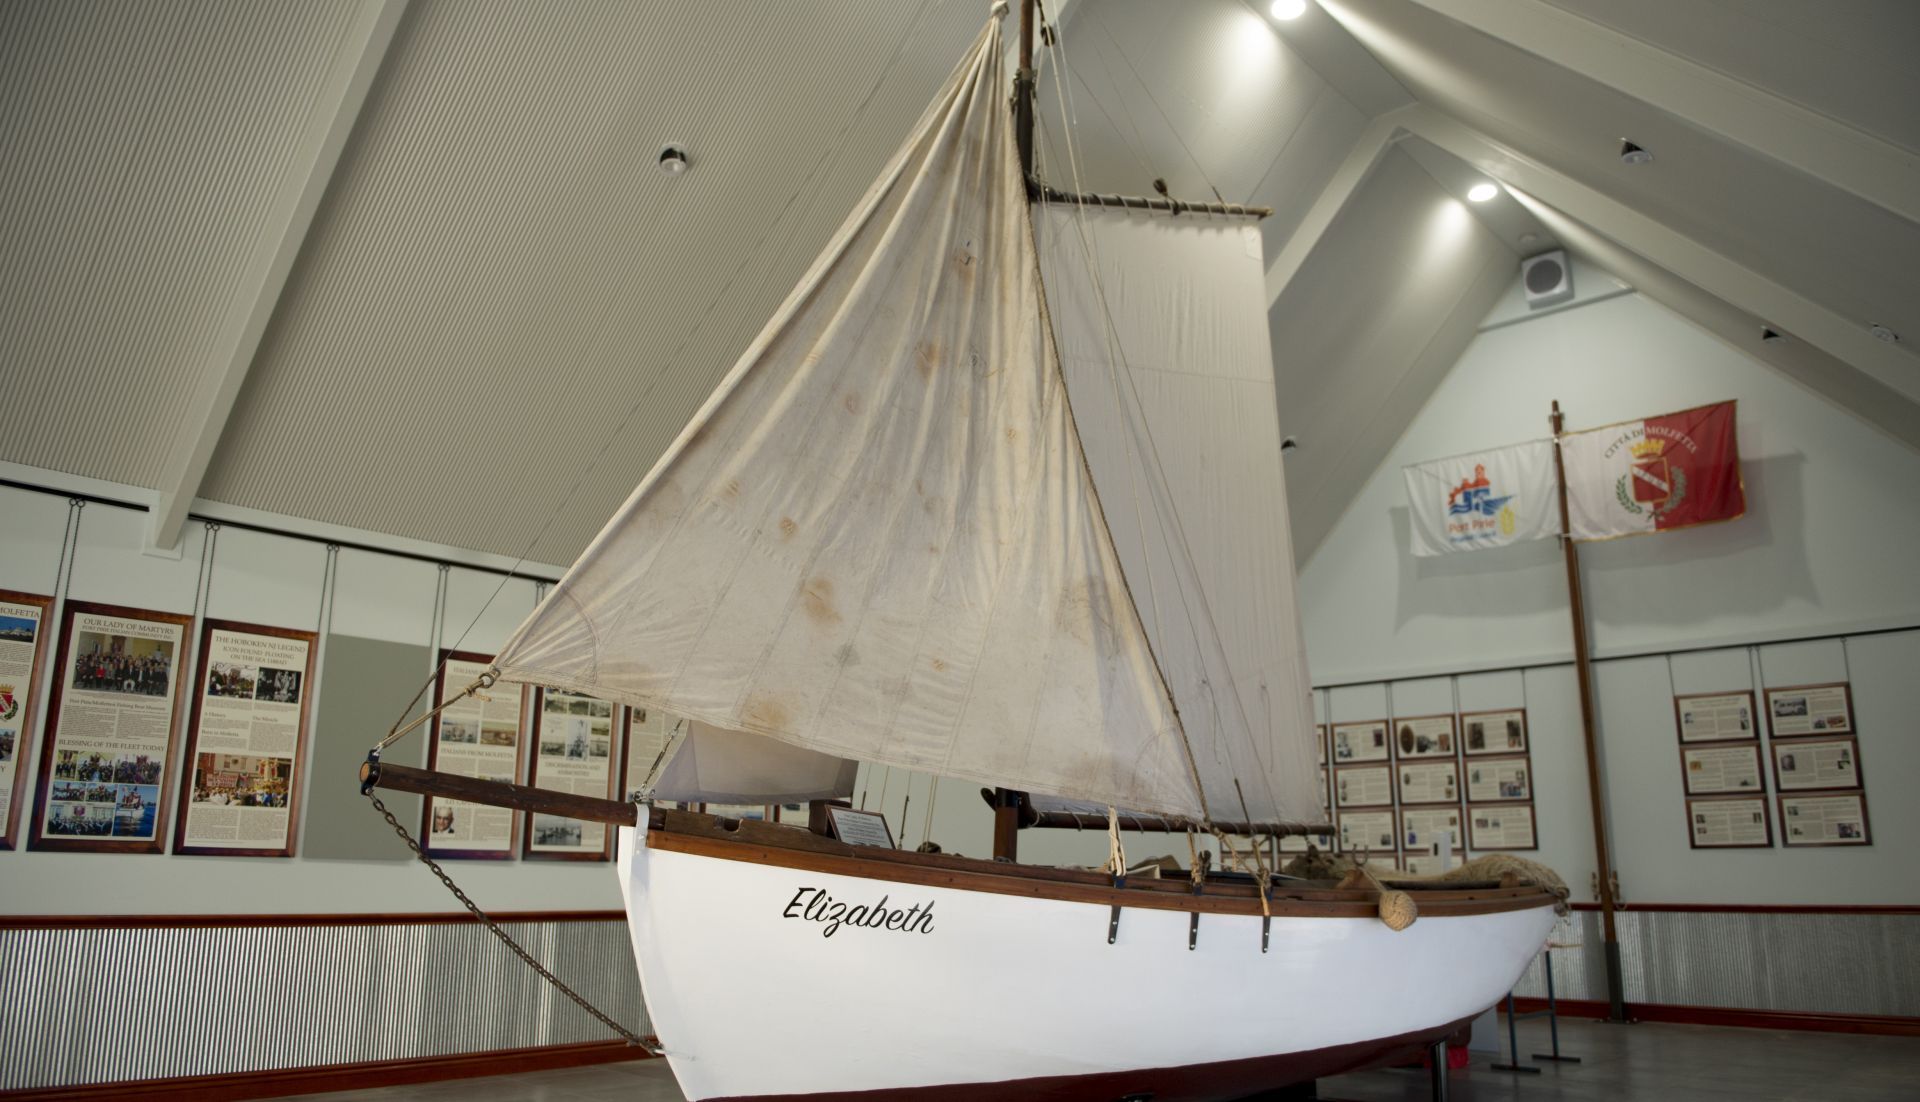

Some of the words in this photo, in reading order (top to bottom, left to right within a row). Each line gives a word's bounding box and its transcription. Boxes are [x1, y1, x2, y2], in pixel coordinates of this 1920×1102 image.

[1632, 428, 1644, 438] DI
[1646, 426, 1697, 454] MOLFETTA
[84, 618, 102, 626] OUR
[104, 620, 124, 628] LADY
[139, 624, 174, 634] MARTYRS
[231, 638, 266, 648] HOBOKEN
[278, 642, 306, 652] LEGEND
[59, 738, 92, 748] BLESSING
[783, 886, 934, 938] Elizabeth
